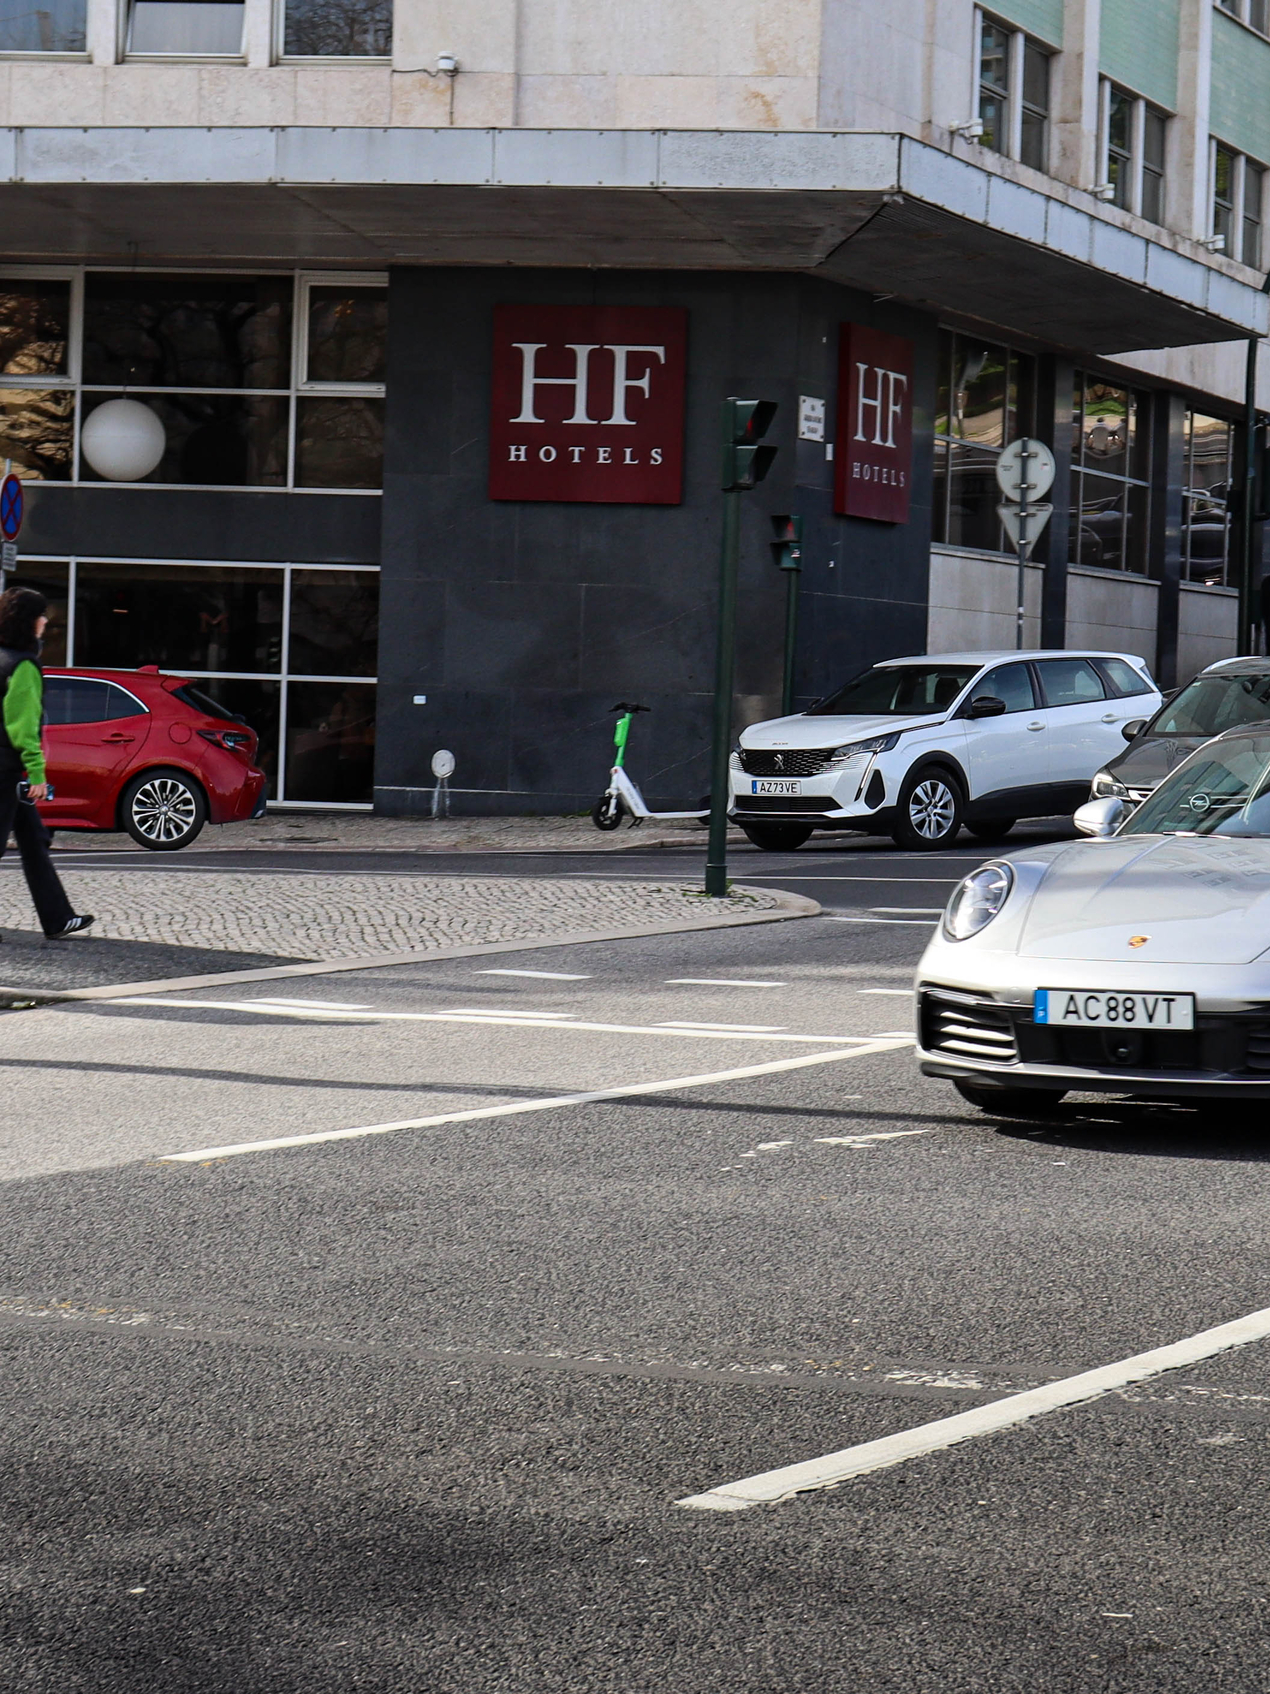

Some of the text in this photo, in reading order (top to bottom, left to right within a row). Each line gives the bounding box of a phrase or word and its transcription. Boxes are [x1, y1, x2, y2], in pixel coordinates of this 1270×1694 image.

[509, 343, 666, 426] HF
[853, 362, 908, 449] HF
[508, 445, 663, 465] HOTELS
[852, 462, 906, 488] HOTELS
